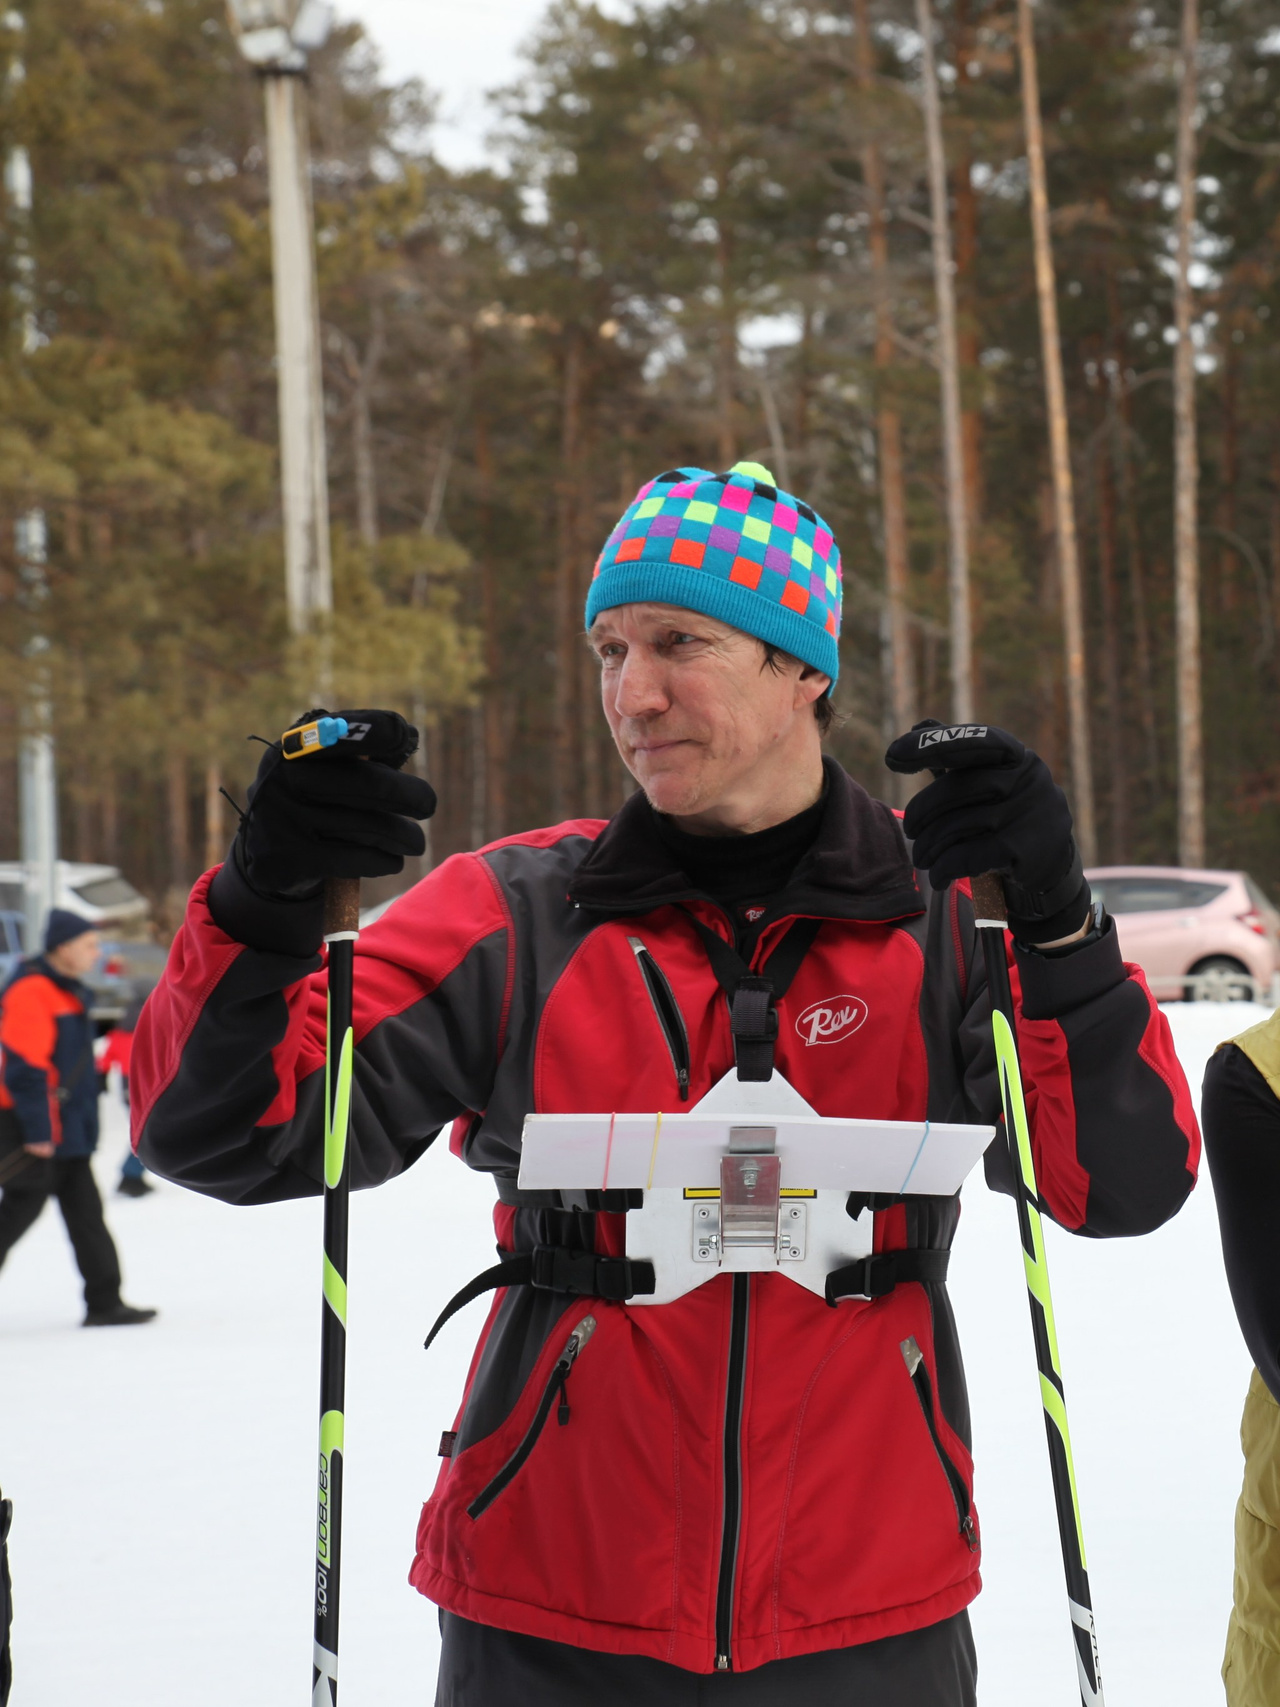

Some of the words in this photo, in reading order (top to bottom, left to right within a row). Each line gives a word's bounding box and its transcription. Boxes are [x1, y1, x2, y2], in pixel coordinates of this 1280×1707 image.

[919, 727, 987, 748] KV+
[802, 1006, 858, 1043] Rex
[317, 1564, 328, 1617] 100%
